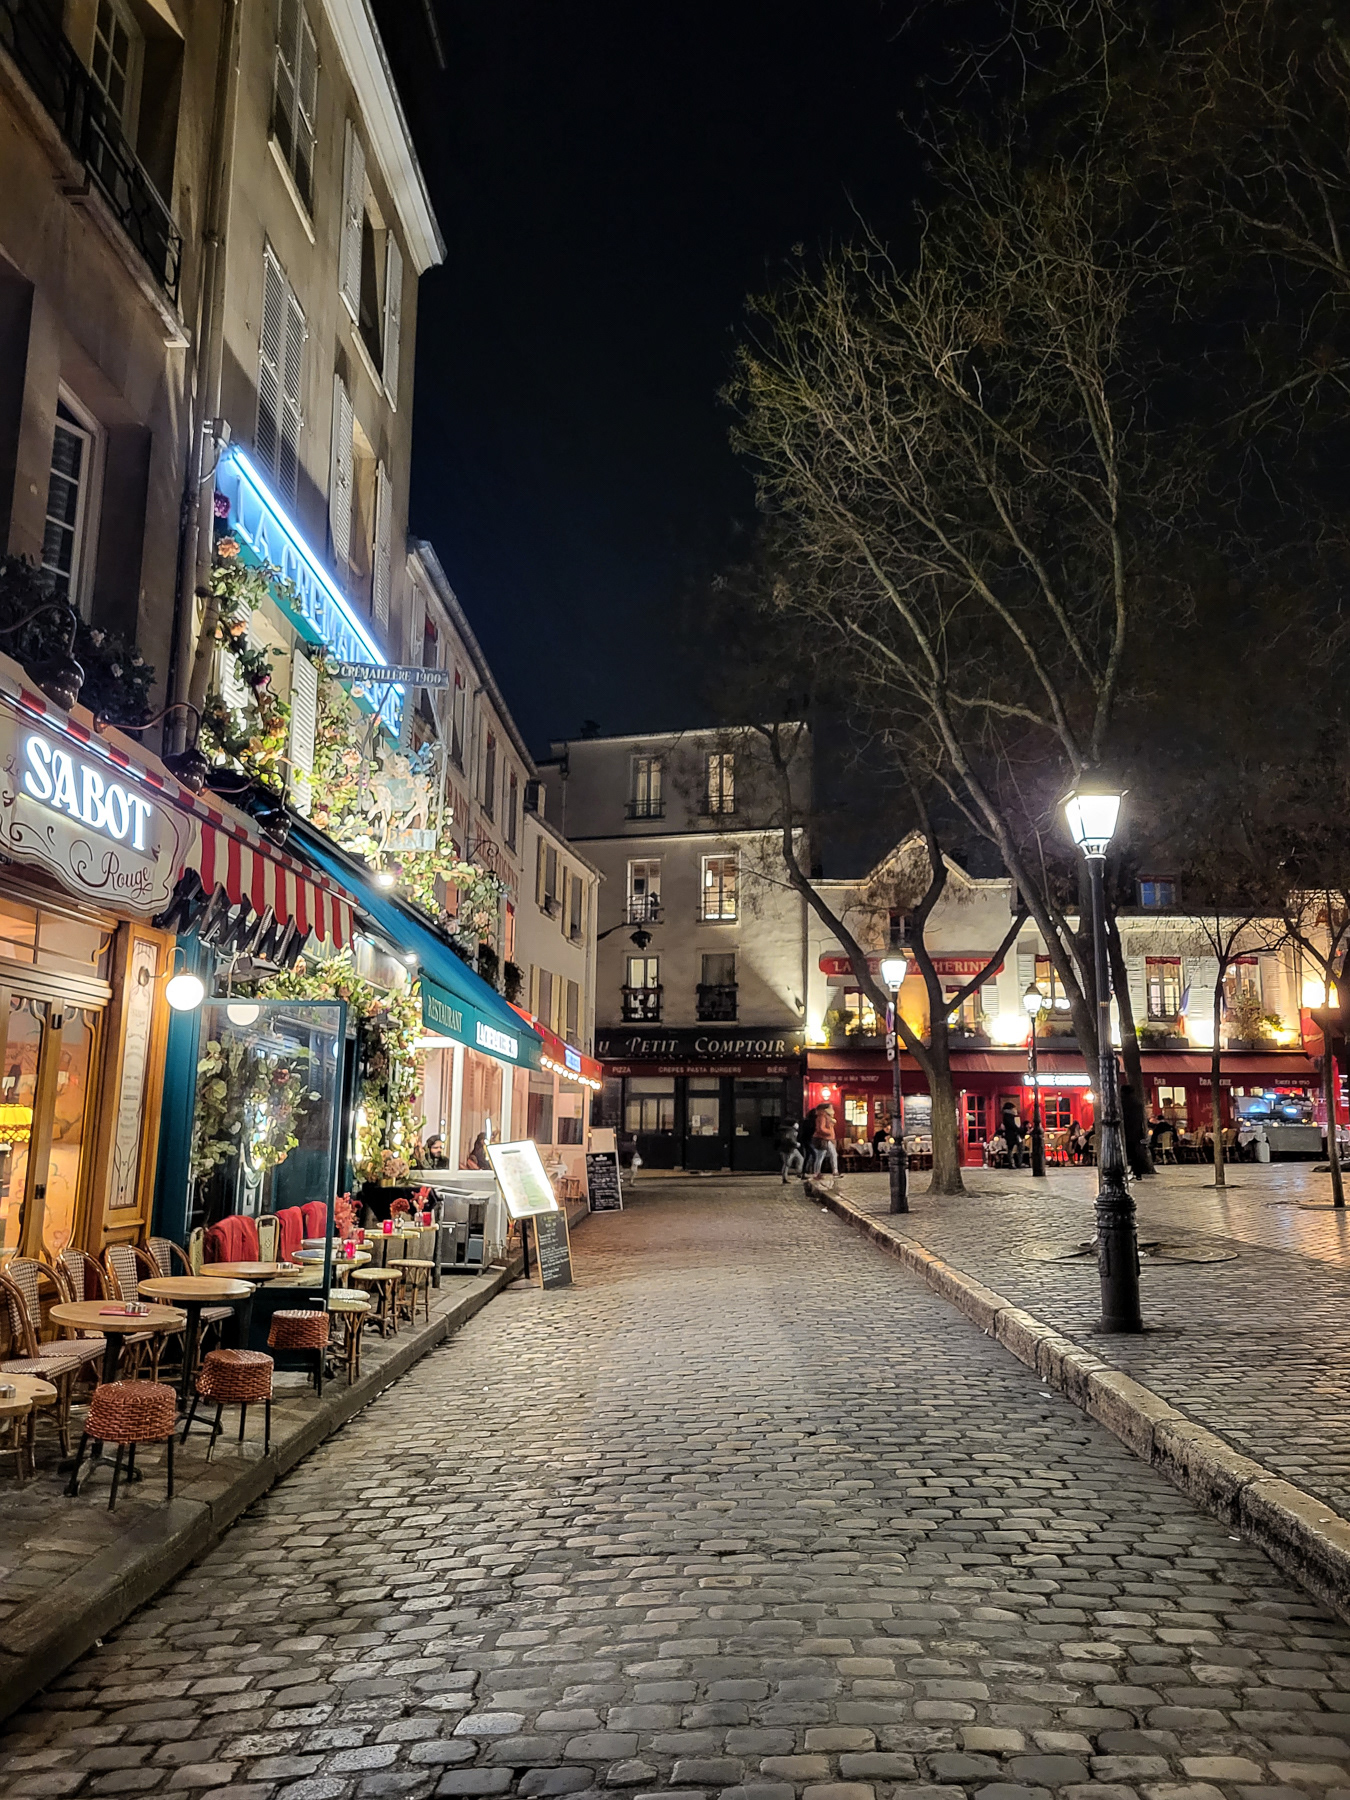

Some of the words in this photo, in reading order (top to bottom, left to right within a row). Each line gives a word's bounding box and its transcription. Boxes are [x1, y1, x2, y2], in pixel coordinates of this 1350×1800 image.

[23, 736, 152, 851] SABOT
[80, 845, 153, 896] Rouge
[832, 961, 851, 972] LA
[427, 994, 463, 1033] RESTAURANT
[625, 1036, 679, 1053] PETIT
[694, 1036, 786, 1054] COMPTOIR
[612, 1066, 631, 1074] PIZZA
